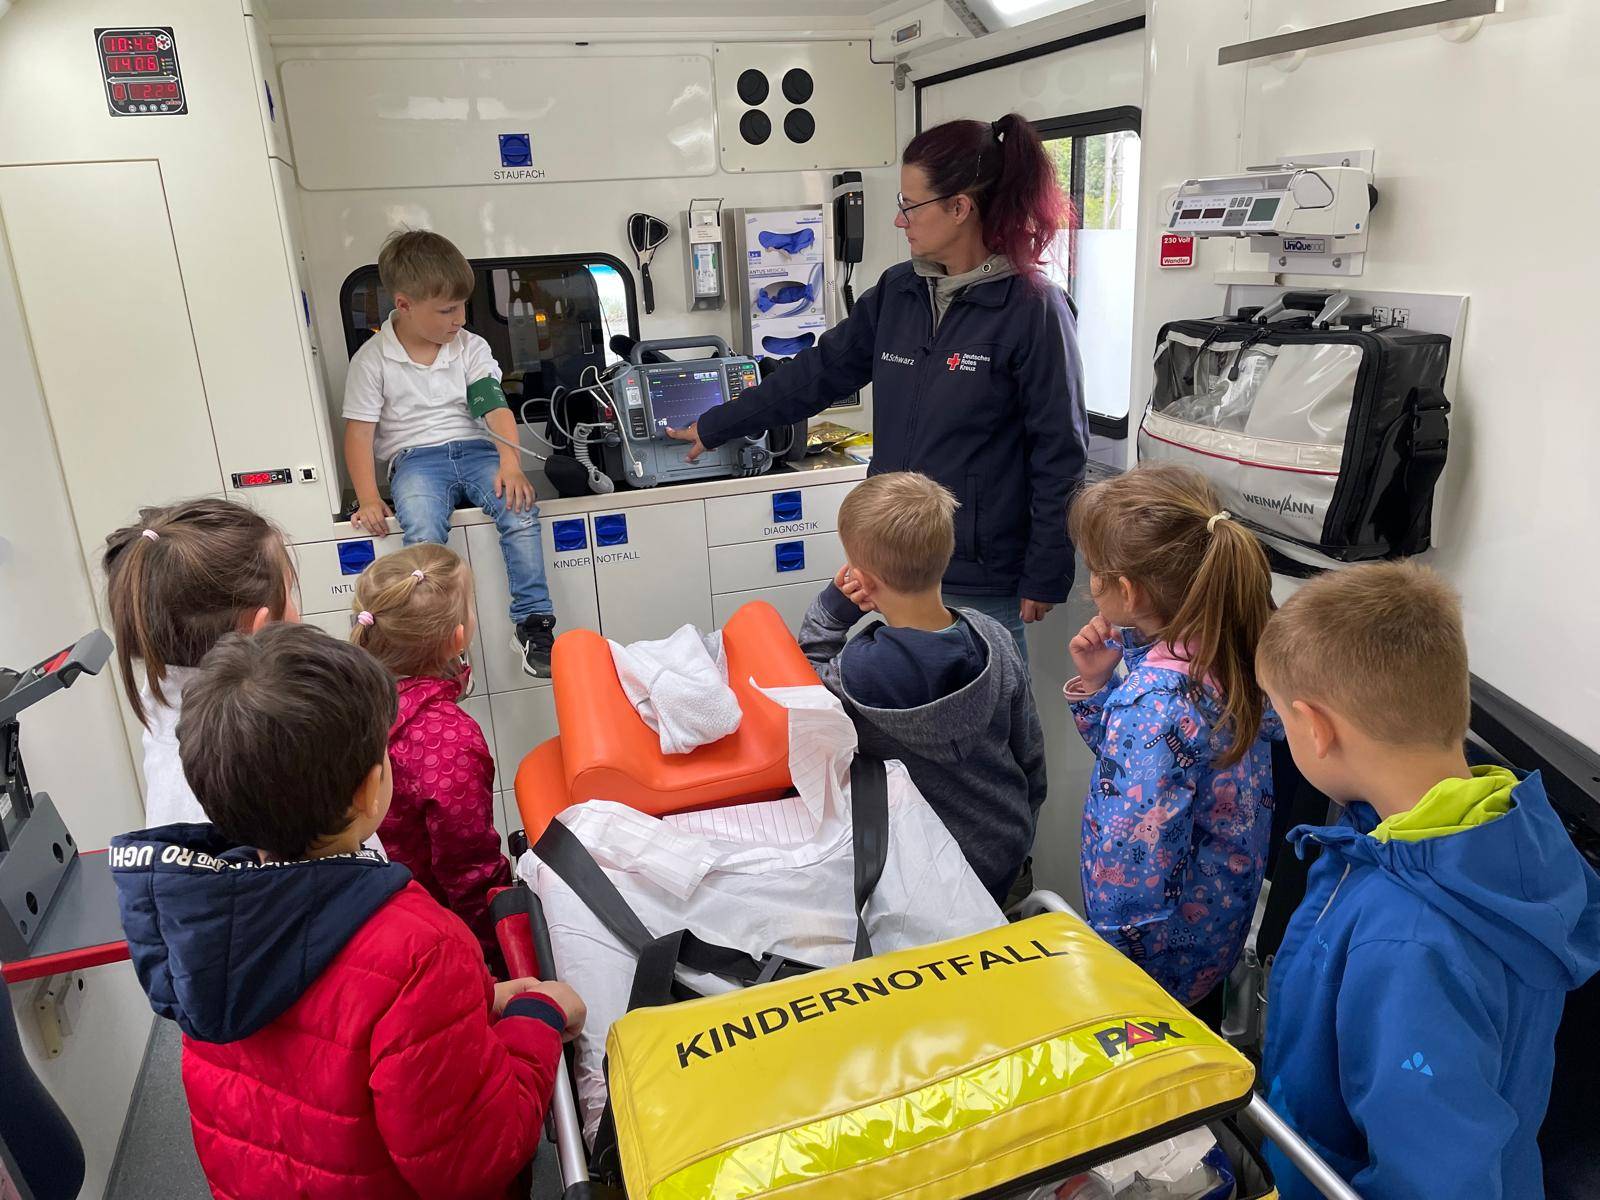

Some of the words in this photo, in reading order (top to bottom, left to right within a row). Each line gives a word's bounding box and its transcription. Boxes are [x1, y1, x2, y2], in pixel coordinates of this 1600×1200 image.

[111, 37, 155, 52] 10:42
[493, 170, 545, 180] STAUFACH
[881, 352, 915, 366] M.Schwarz
[963, 353, 991, 362] Deutsches
[959, 364, 976, 372] Kreuz
[1242, 492, 1315, 515] WEINMANN
[763, 521, 819, 536] DIAGNOSTIK
[553, 557, 591, 569] KINDER
[596, 551, 640, 563] NOTFALL
[197, 854, 226, 871] AND
[675, 939, 1069, 1069] KINDERNOTFALL
[1093, 1020, 1187, 1058] PAX
